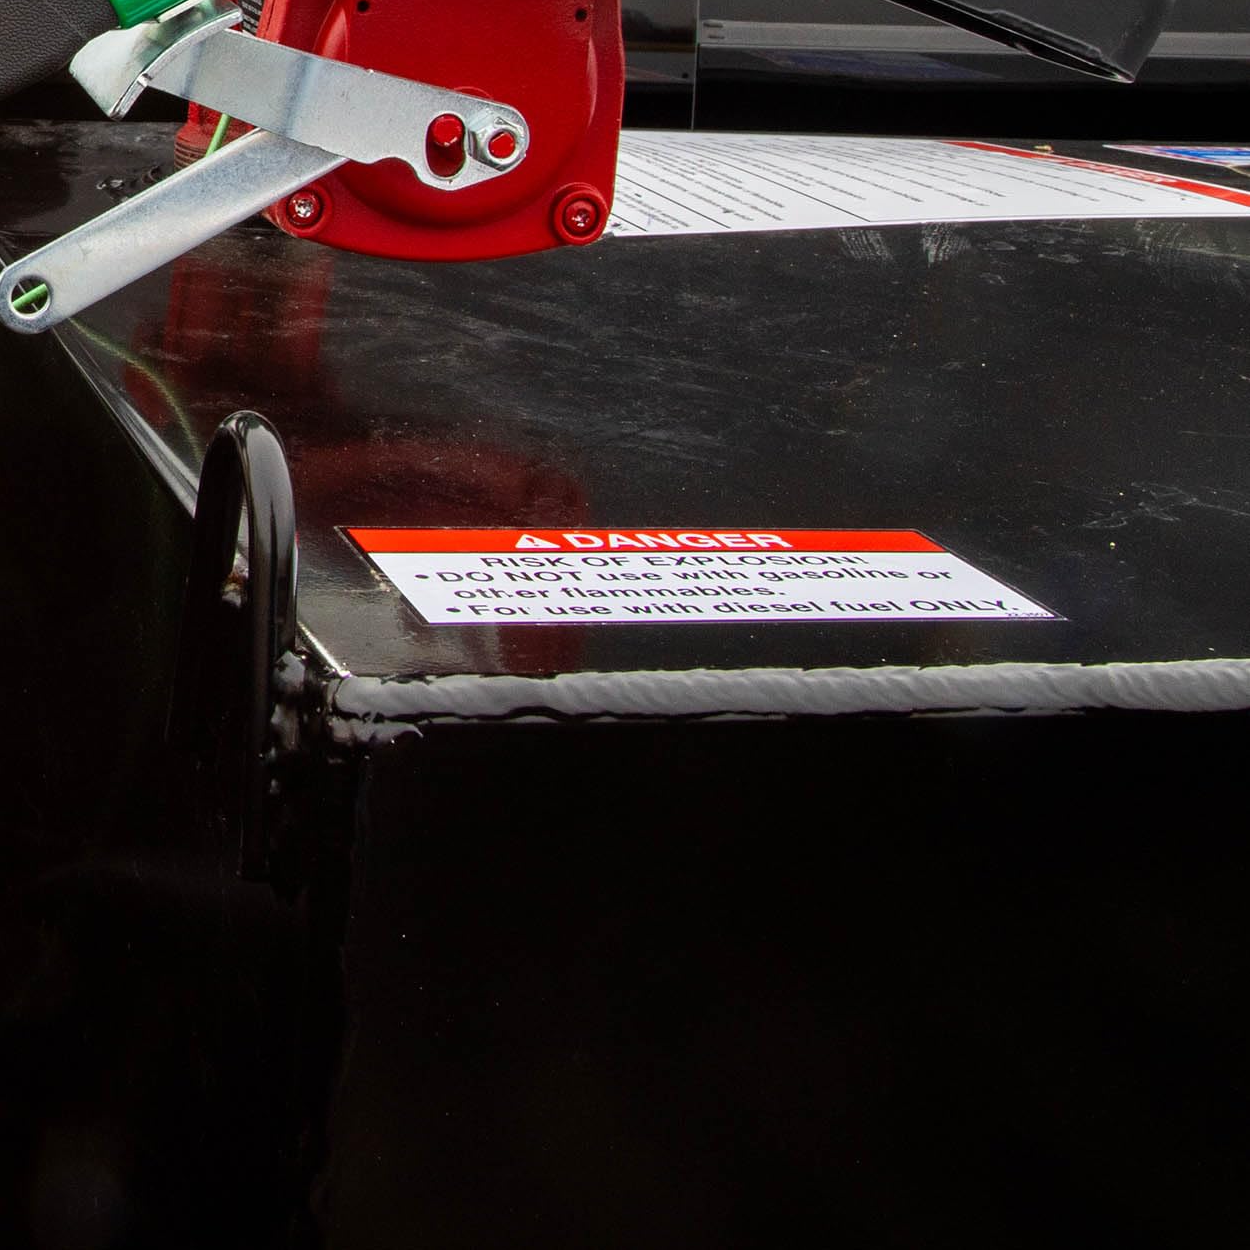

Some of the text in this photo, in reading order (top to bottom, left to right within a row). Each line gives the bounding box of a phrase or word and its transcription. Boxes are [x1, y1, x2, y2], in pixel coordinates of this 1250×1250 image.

[563, 533, 793, 549] DANGER
[480, 556, 870, 567] RISK OF EXPLOSION!
[436, 568, 954, 582] DO NOT use with gasoline or
[454, 583, 786, 599] other flammables.
[468, 599, 1019, 616] For use with diesel fuel ONLY.
